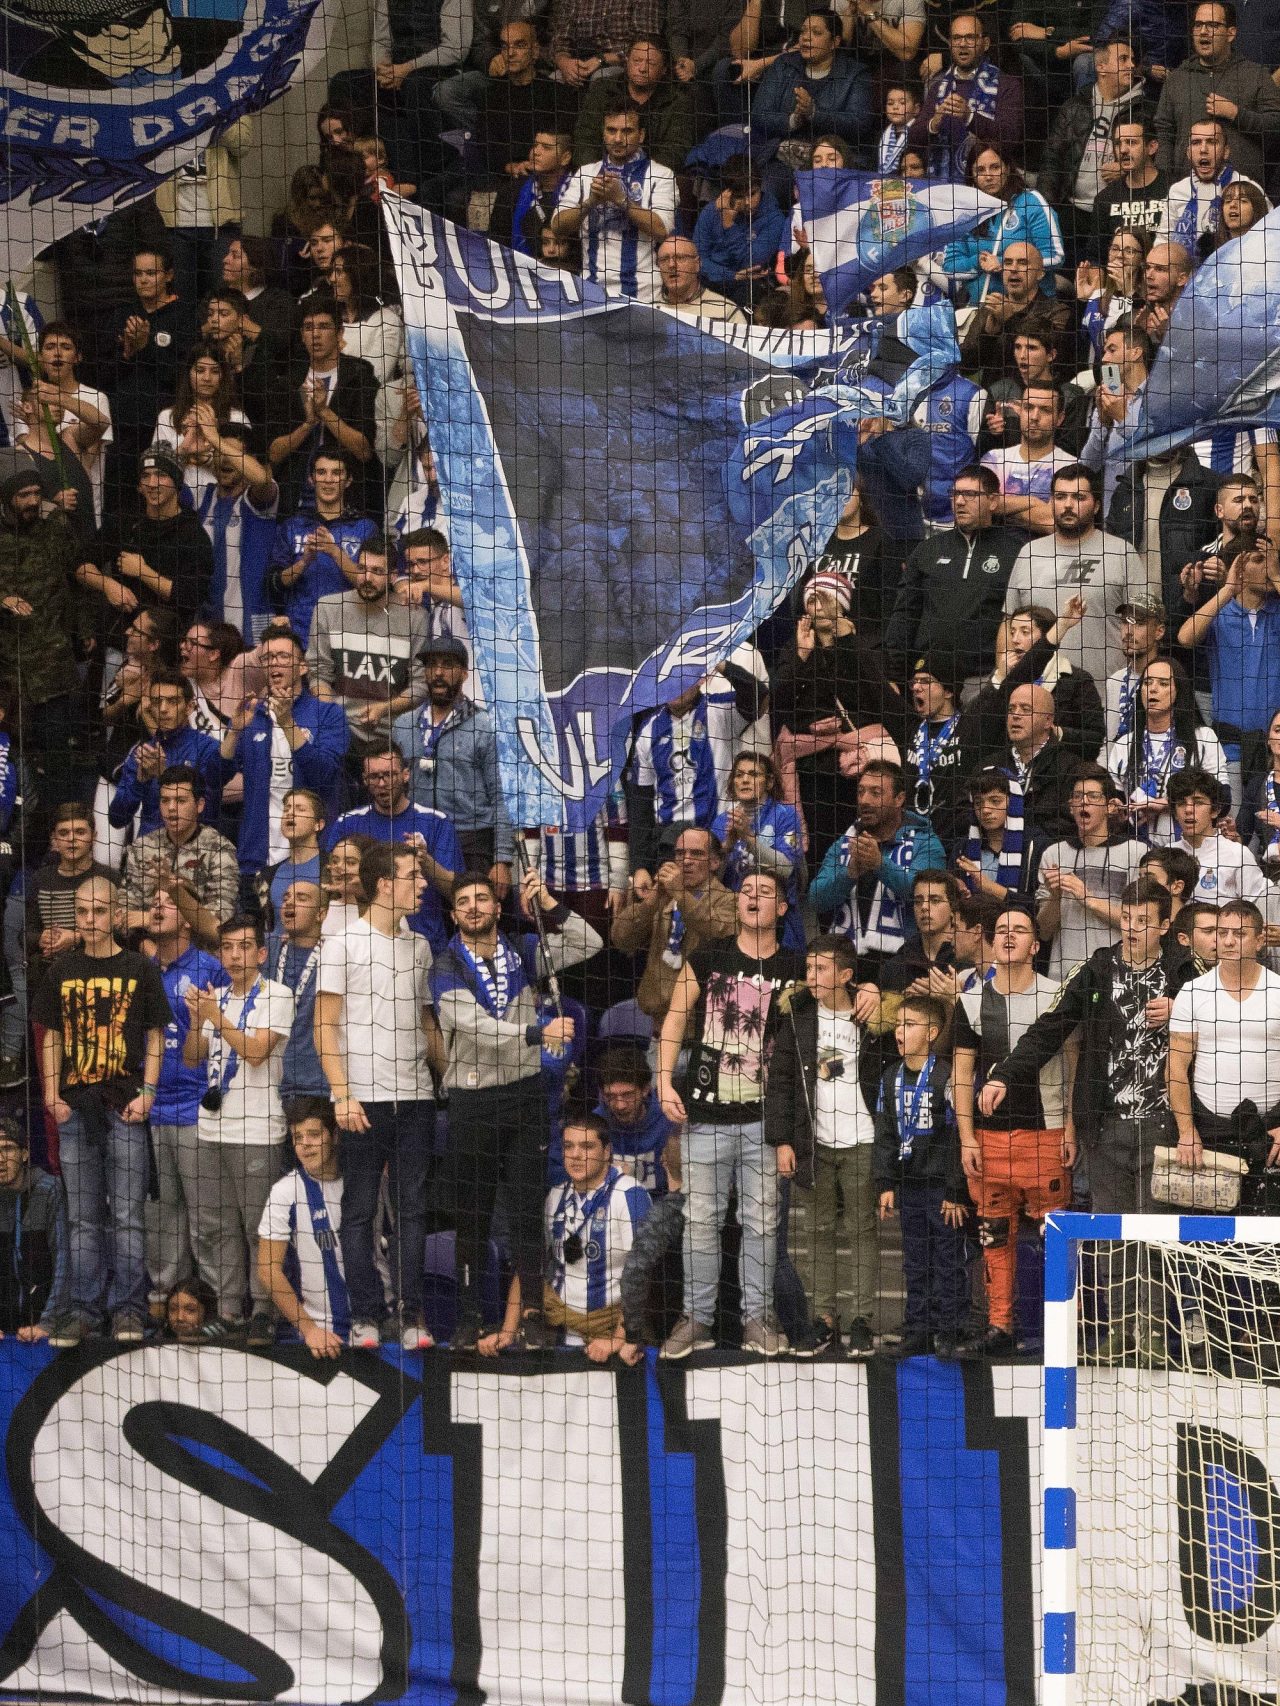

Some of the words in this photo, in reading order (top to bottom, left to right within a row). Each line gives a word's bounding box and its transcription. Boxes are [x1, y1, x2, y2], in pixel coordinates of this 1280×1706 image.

[0, 104, 100, 149] ER
[1110, 200, 1168, 216] EAGLES
[1123, 215, 1155, 226] TEAM
[815, 553, 861, 575] Call
[342, 651, 398, 685] LAX
